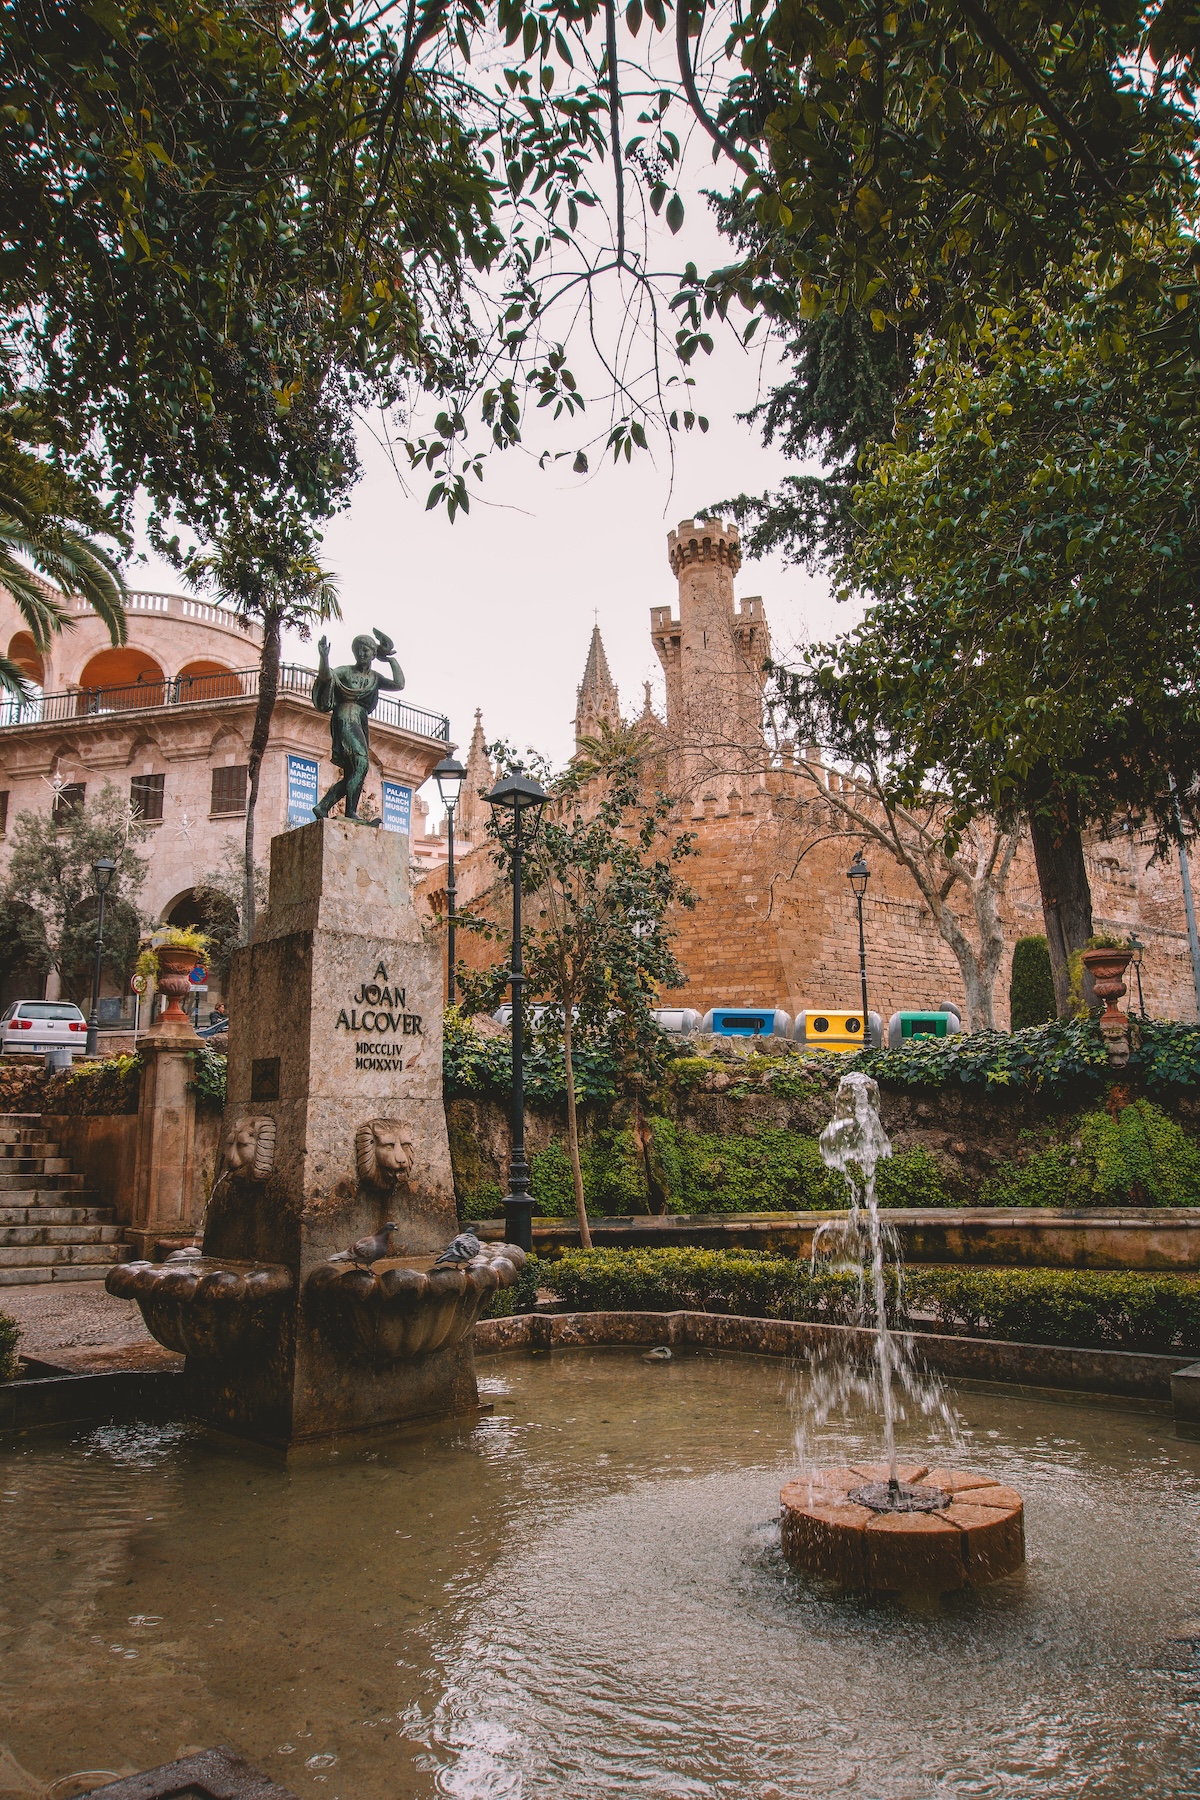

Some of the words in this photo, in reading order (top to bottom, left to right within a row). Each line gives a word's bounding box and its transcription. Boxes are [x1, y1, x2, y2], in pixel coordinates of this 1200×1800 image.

[291, 761, 316, 773] PALAU
[290, 769, 317, 781] MARCH
[290, 777, 317, 789] MUSEO
[291, 790, 314, 802] HOUSE
[386, 787, 408, 799] PALAU
[385, 795, 409, 807] MARCH
[385, 802, 409, 814] MUSEO
[387, 815, 407, 826] HOUSE
[384, 822, 409, 835] MUSEUM
[373, 961, 388, 981] A
[354, 984, 406, 1008] JOAN
[355, 1041, 403, 1056] MDCCCLIV
[355, 1057, 403, 1072] MCMXXVI
